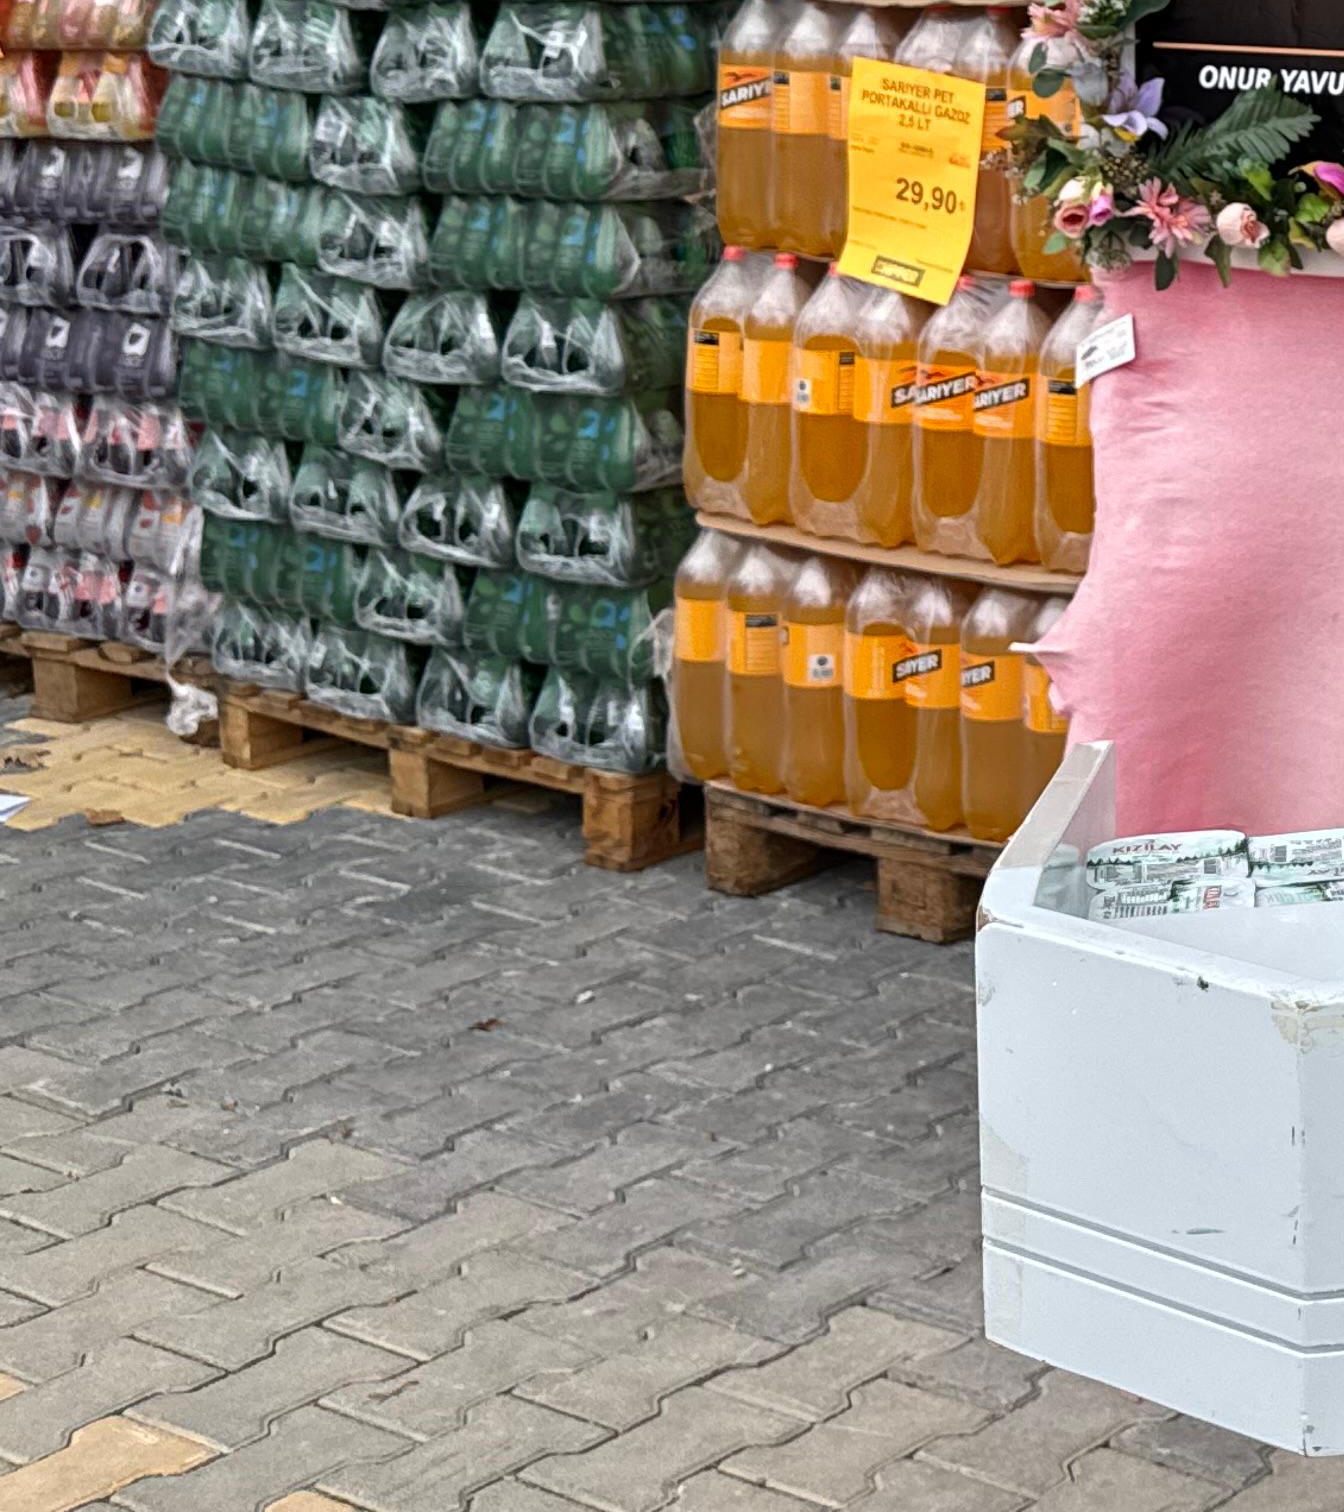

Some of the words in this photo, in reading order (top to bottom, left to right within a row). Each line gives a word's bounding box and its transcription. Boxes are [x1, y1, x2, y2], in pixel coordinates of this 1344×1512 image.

[1199, 65, 1272, 91] ONUR
[934, 88, 955, 104] PET
[896, 177, 957, 214] 29,90
